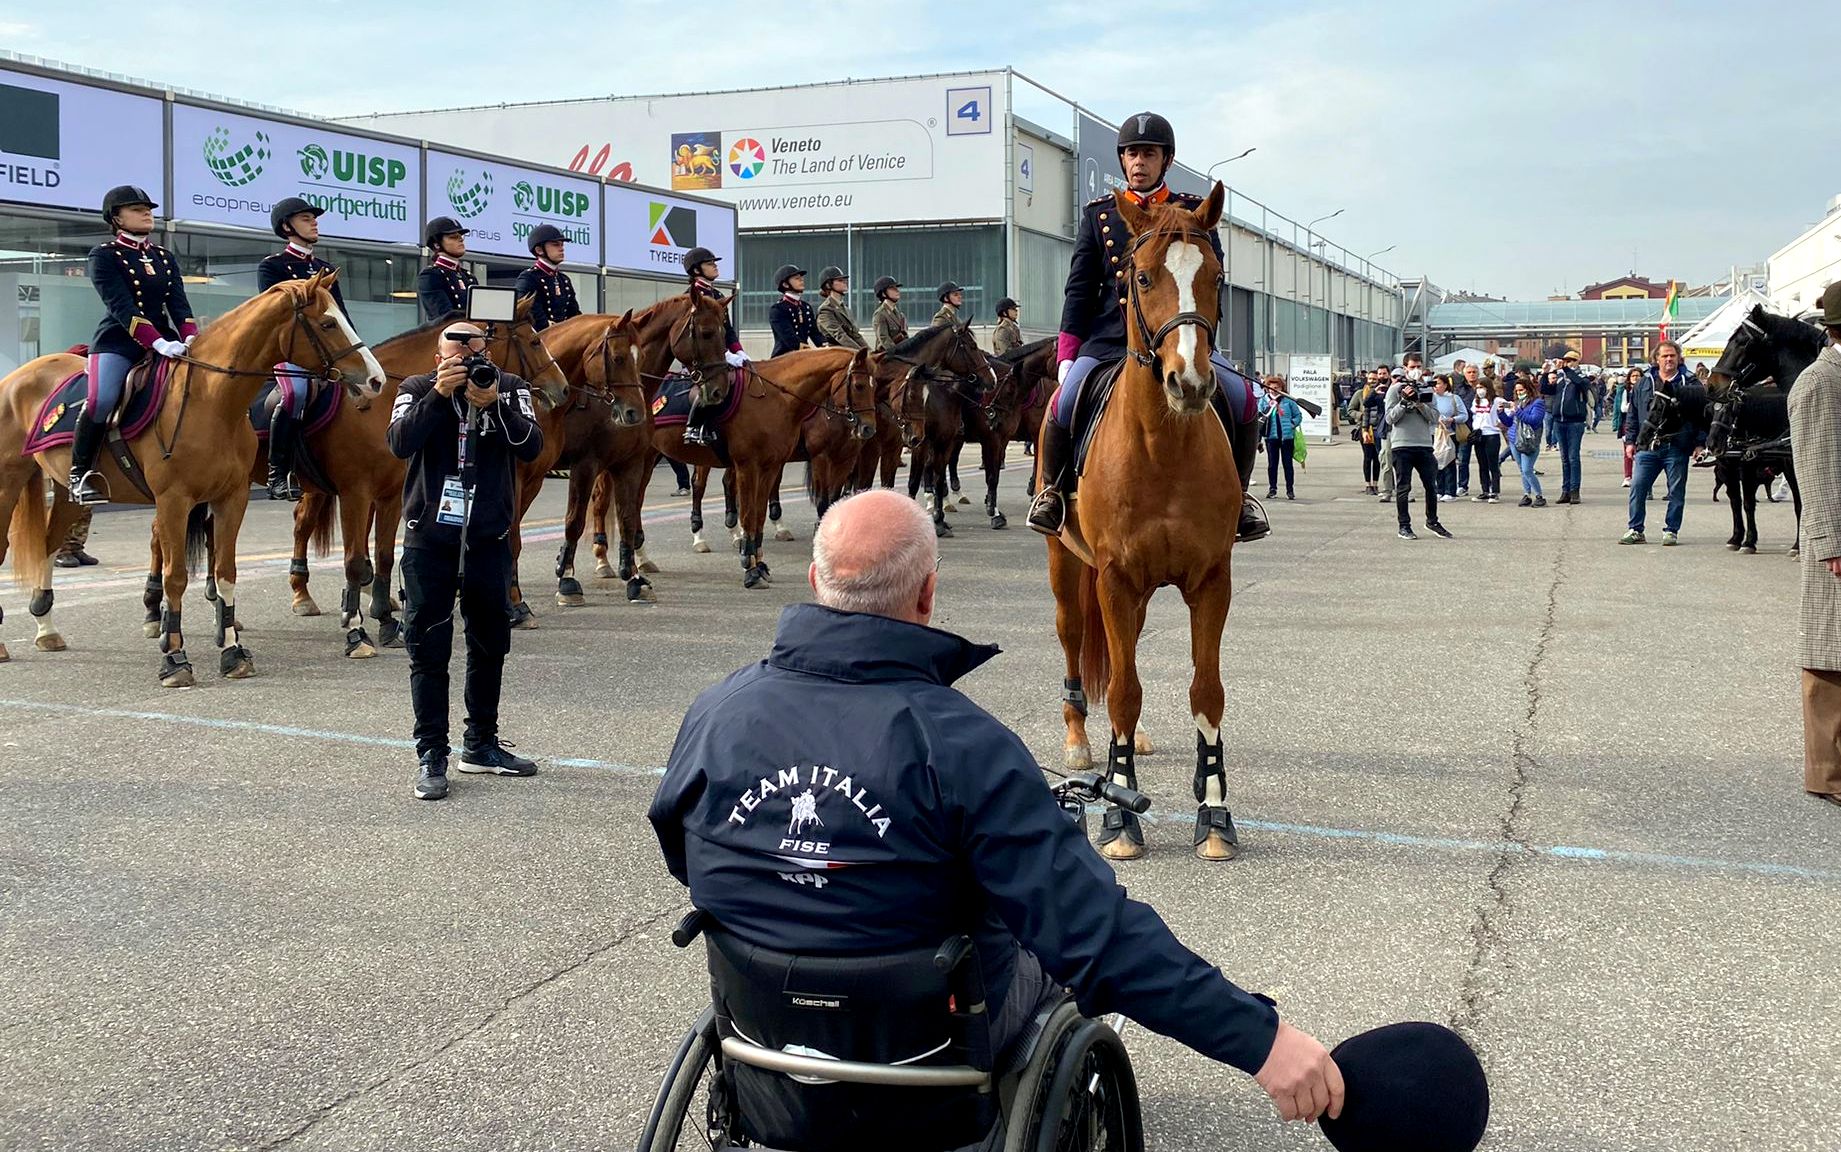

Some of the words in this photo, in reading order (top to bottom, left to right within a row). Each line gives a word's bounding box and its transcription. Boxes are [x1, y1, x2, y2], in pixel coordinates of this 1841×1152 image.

[957, 100, 981, 122] 4
[771, 137, 821, 154] Veneto
[332, 149, 407, 189] UISP
[771, 158, 797, 175] The
[801, 154, 836, 174] Land
[838, 154, 855, 172] of
[858, 152, 906, 171] Venice
[1020, 158, 1030, 180] 4
[1088, 169, 1096, 193] 4
[192, 193, 275, 214] ecopneu
[536, 185, 590, 218] UISP
[738, 193, 853, 211] www.veneto.eu
[727, 765, 800, 826] TEAM
[809, 765, 893, 839] ITALIA
[778, 838, 831, 855] FISE
